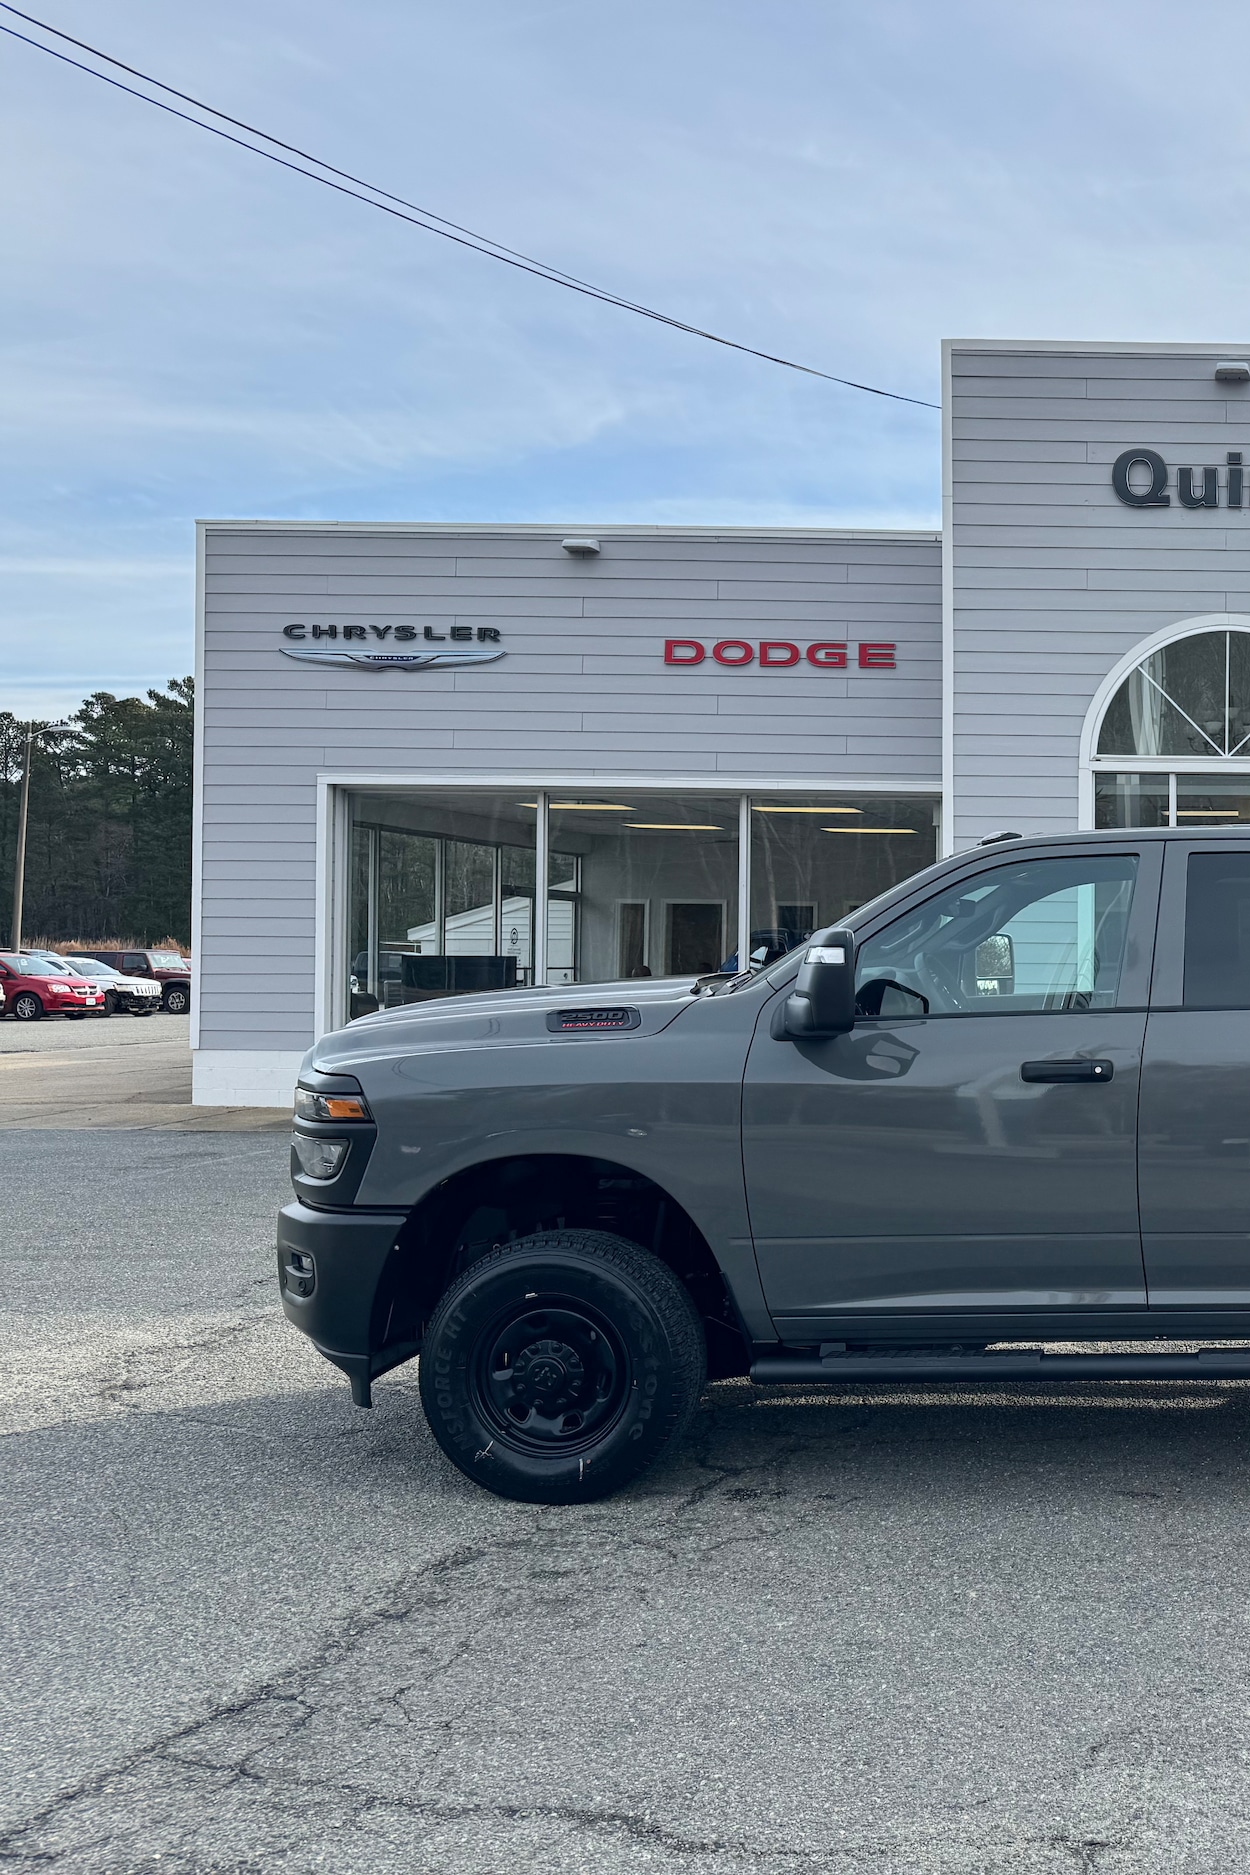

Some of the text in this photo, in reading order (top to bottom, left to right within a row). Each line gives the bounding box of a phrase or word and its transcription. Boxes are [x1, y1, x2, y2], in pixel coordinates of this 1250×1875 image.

[282, 623, 502, 642] CHRYSLER
[664, 639, 897, 669] DODGE
[561, 1011, 624, 1021] 2500
